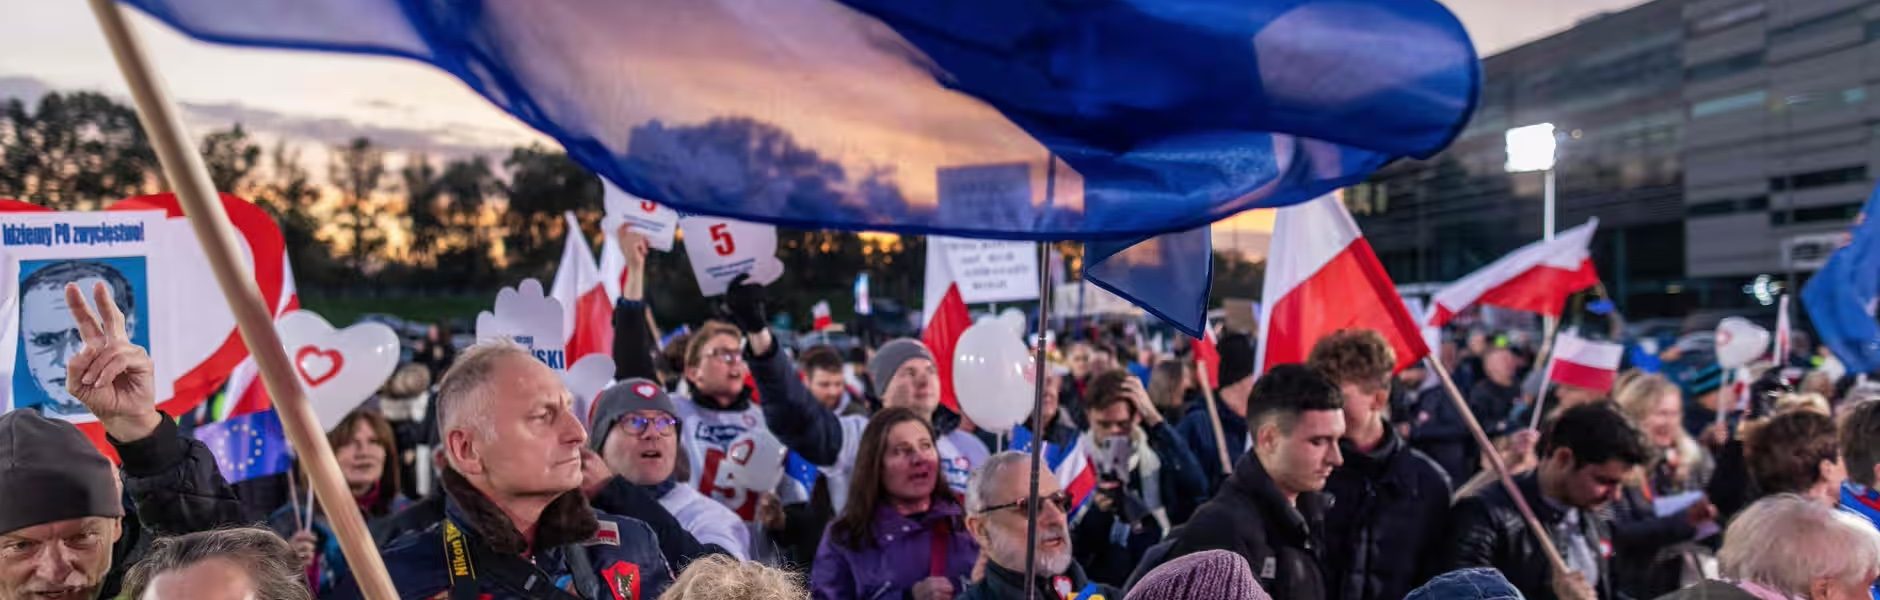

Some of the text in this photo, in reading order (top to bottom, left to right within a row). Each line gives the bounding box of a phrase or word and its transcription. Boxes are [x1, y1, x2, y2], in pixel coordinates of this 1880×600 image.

[54, 223, 71, 244] PO
[708, 223, 735, 256] 5
[452, 540, 469, 576] Nikon
